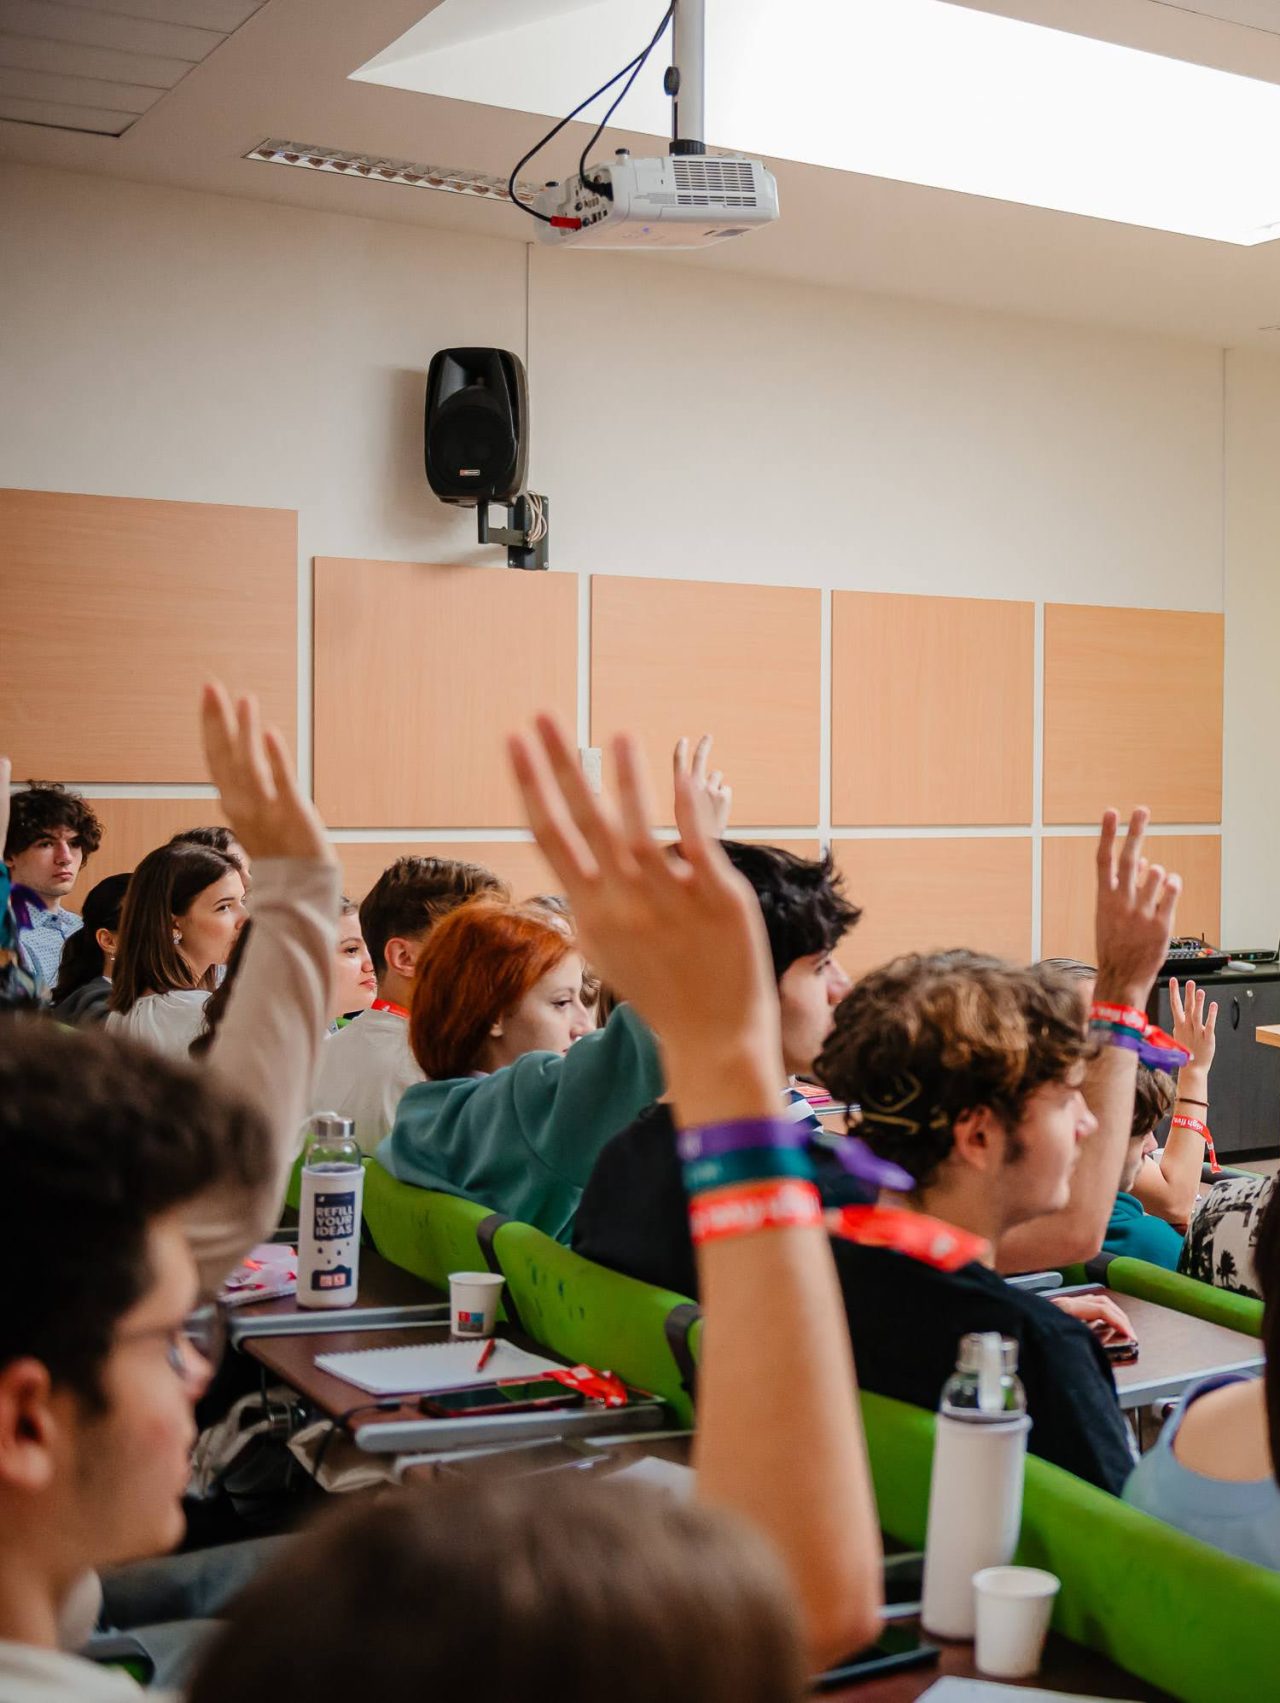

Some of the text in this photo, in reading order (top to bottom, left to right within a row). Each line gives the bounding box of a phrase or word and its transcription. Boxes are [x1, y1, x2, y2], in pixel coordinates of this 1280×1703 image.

[316, 1205, 353, 1217] REFILL
[316, 1215, 353, 1226] YOUR
[316, 1224, 352, 1237] IDEAS
